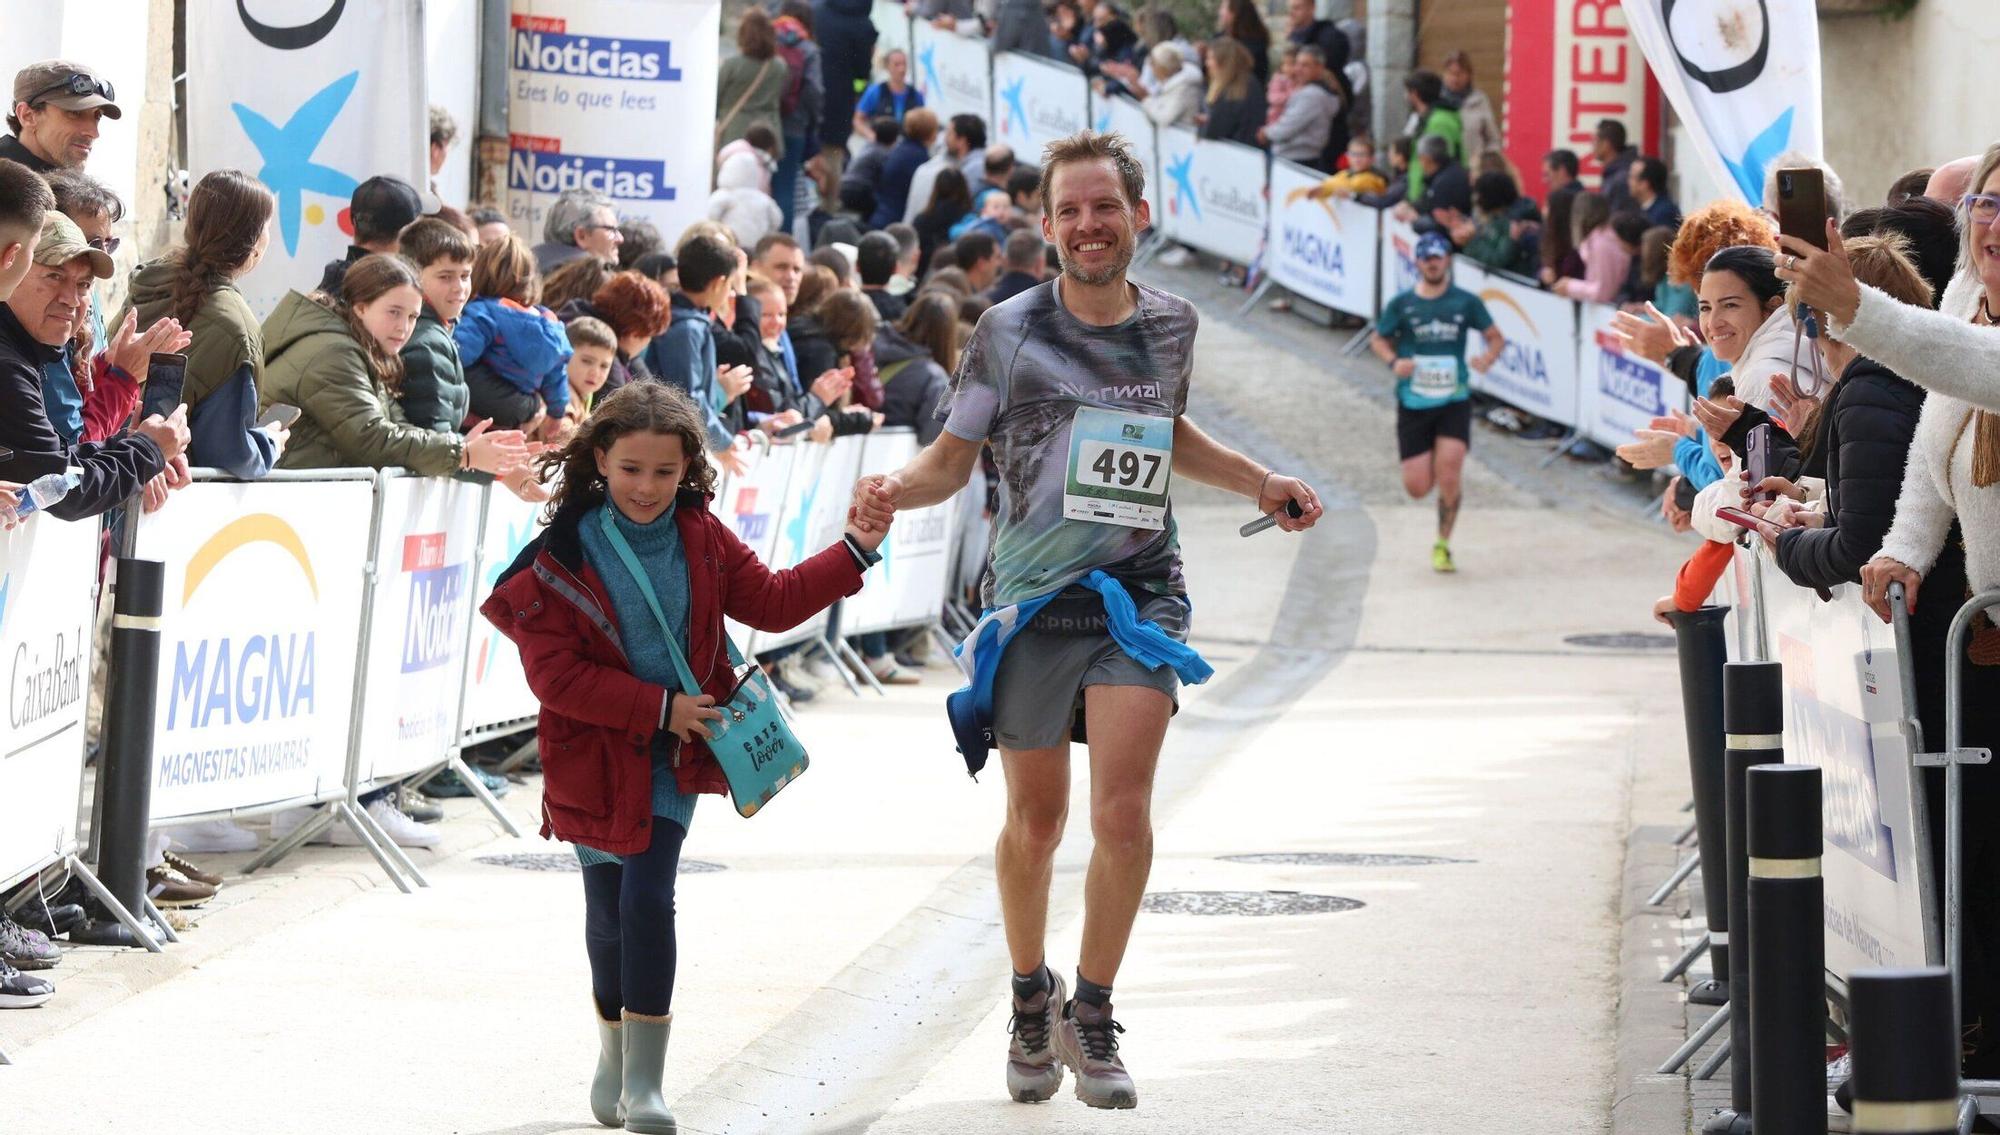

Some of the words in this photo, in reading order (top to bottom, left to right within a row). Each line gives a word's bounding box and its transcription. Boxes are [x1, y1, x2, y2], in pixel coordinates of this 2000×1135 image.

[517, 32, 660, 79] Noticias
[517, 80, 548, 101] Eres
[554, 86, 569, 104] lo
[577, 91, 613, 111] que
[620, 91, 657, 110] lees
[511, 151, 654, 198] Noticias
[1092, 448, 1162, 489] 497
[9, 624, 82, 730] CaixaBank
[166, 631, 315, 731] MAGNA
[743, 721, 778, 752] CATS
[158, 746, 248, 788] MAGNESITAS
[249, 737, 311, 777] NAVARRAS
